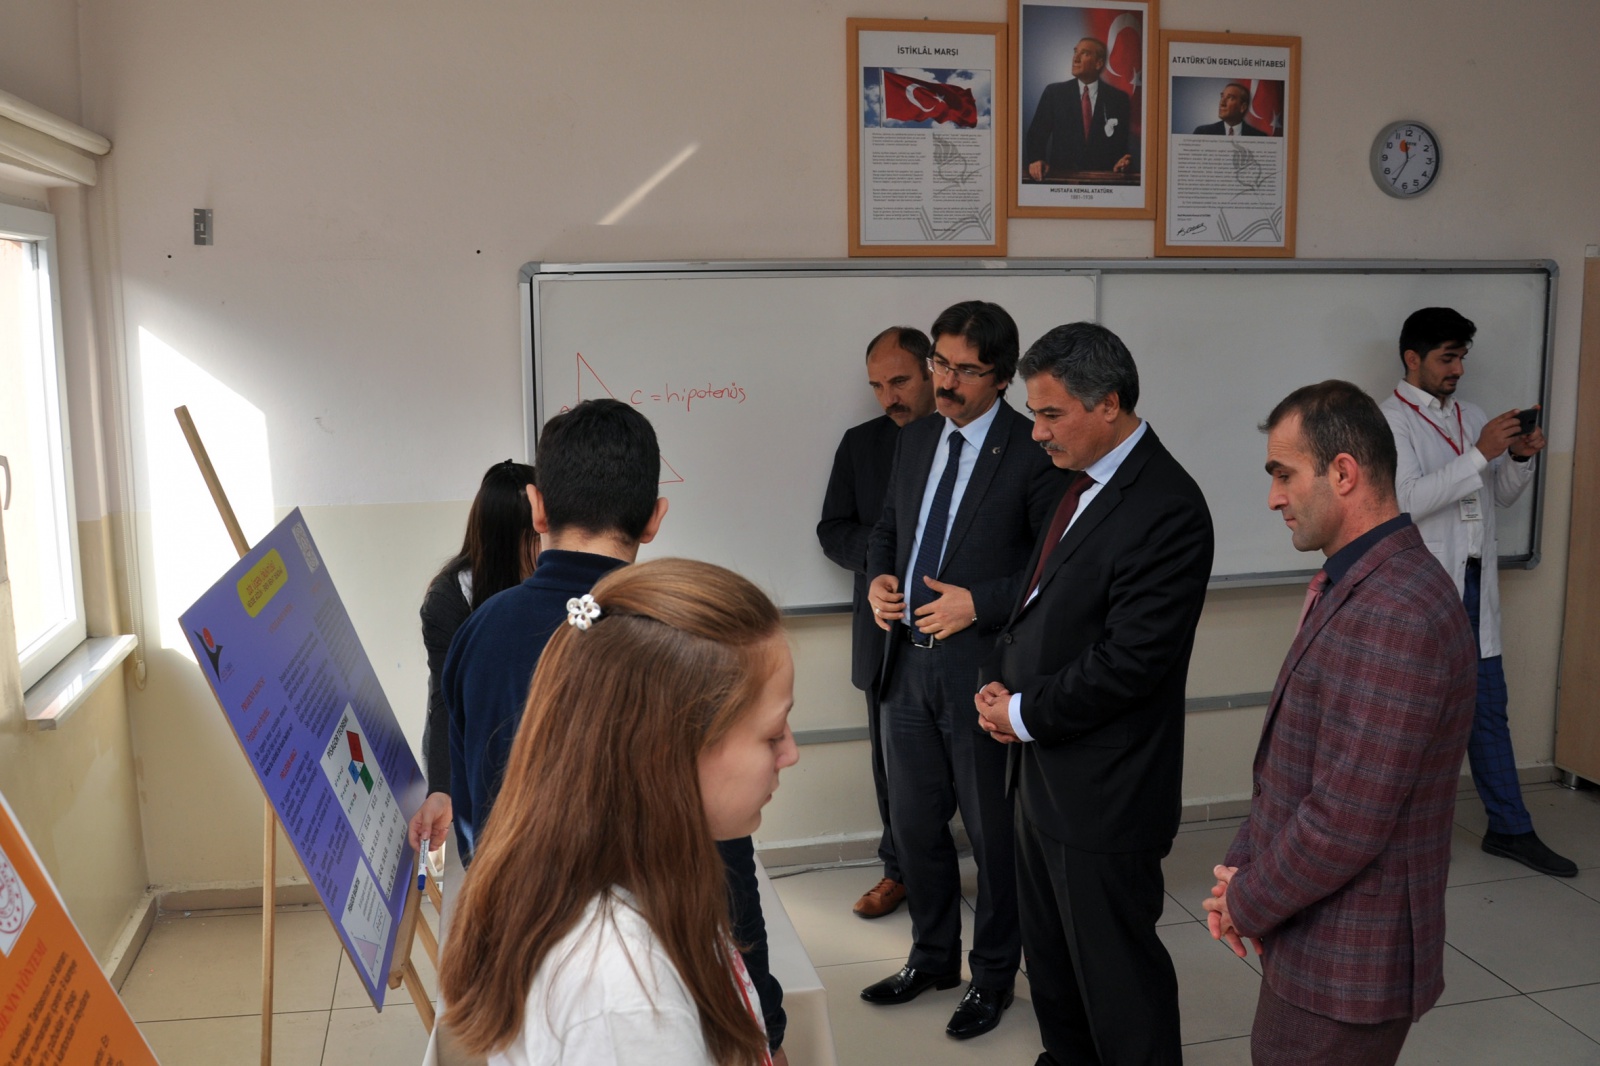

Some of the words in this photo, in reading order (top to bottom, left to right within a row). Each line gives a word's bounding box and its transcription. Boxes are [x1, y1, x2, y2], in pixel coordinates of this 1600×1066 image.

[897, 45, 932, 55] İSTİKLÂL
[934, 47, 959, 56] MARŞI
[1172, 56, 1217, 65] ATATÜRK'ÜN
[1218, 58, 1253, 67] GENÇLİĞE
[1254, 59, 1286, 68] HİTABESİ
